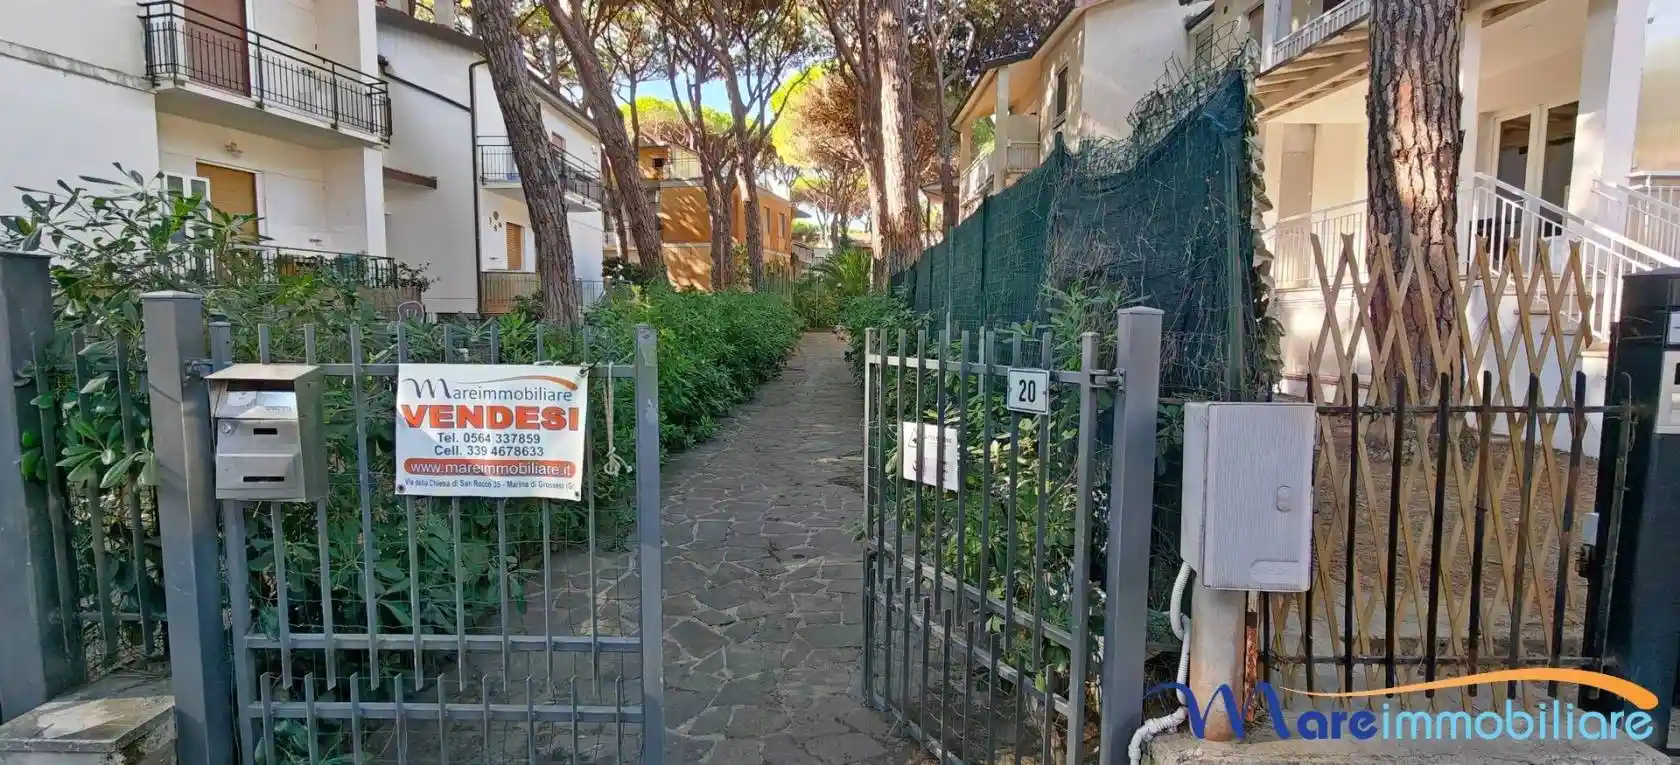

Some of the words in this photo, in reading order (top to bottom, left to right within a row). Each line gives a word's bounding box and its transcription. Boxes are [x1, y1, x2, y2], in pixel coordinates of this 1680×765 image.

[402, 378, 573, 401] Mareimmobiliare
[1018, 379, 1036, 403] 20
[400, 404, 580, 431] VENDESI
[437, 432, 459, 443] Tel.
[463, 432, 491, 443] 0564
[495, 433, 541, 444] 337859
[434, 445, 462, 456] Cell.
[467, 445, 488, 456] 339
[491, 446, 544, 457] 4678633
[411, 460, 572, 476] www.mareimmobiliare.it
[460, 479, 473, 487] San
